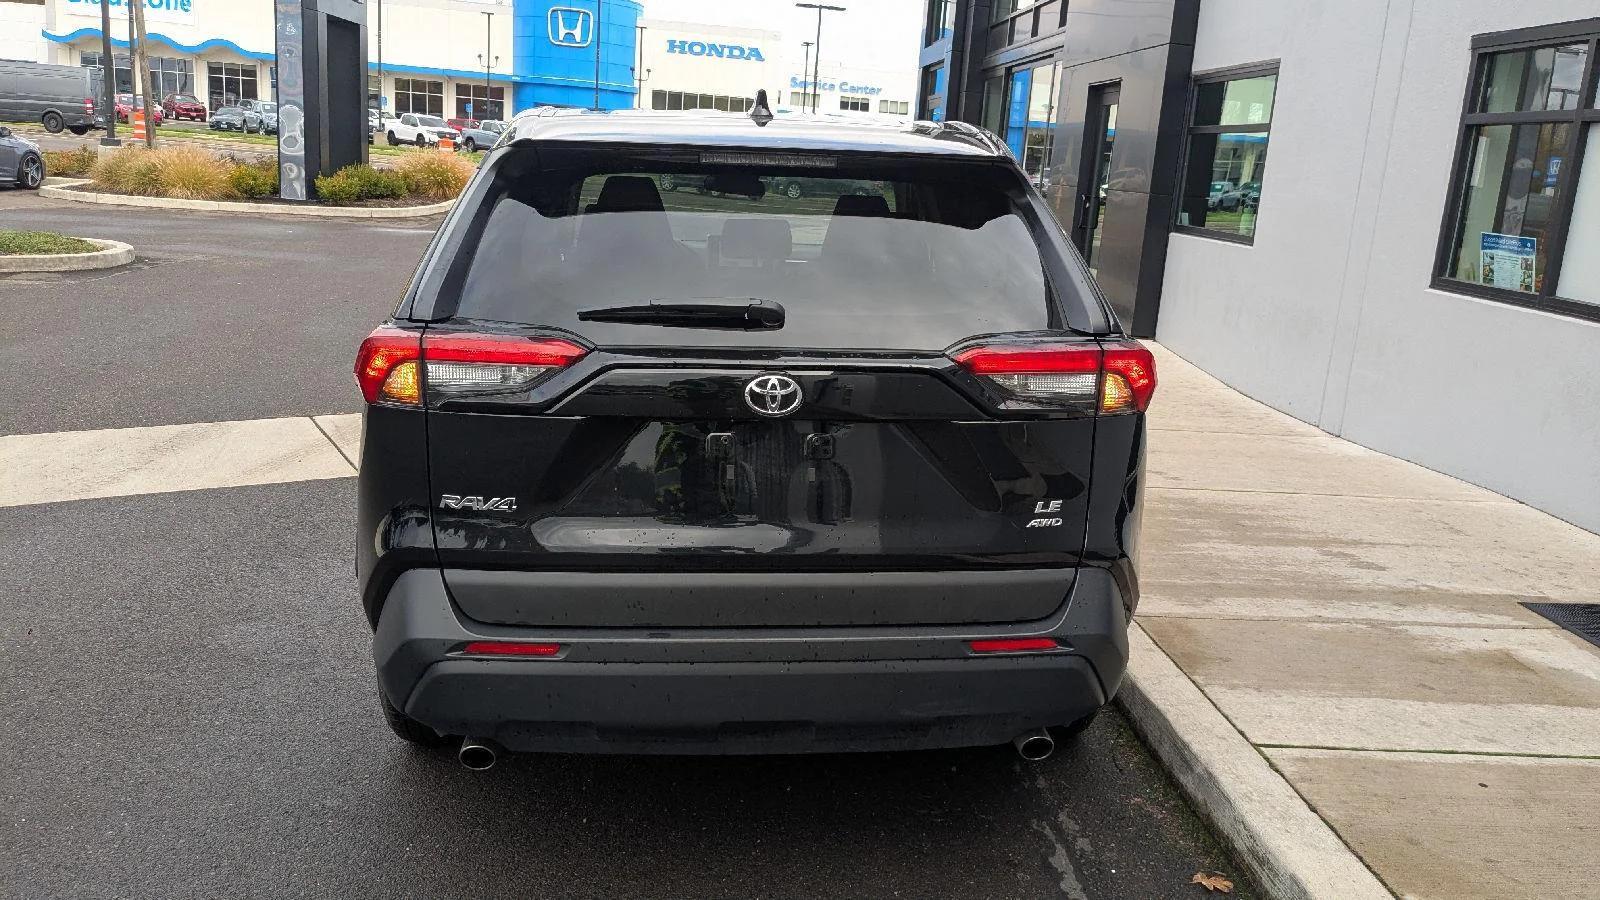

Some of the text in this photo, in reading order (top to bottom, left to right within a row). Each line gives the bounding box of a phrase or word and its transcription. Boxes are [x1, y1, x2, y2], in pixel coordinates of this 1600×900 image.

[667, 40, 765, 62] HONDA
[839, 81, 882, 95] Center
[439, 494, 518, 512] RAV4
[1034, 499, 1063, 514] LE
[1026, 517, 1063, 528] AWD
